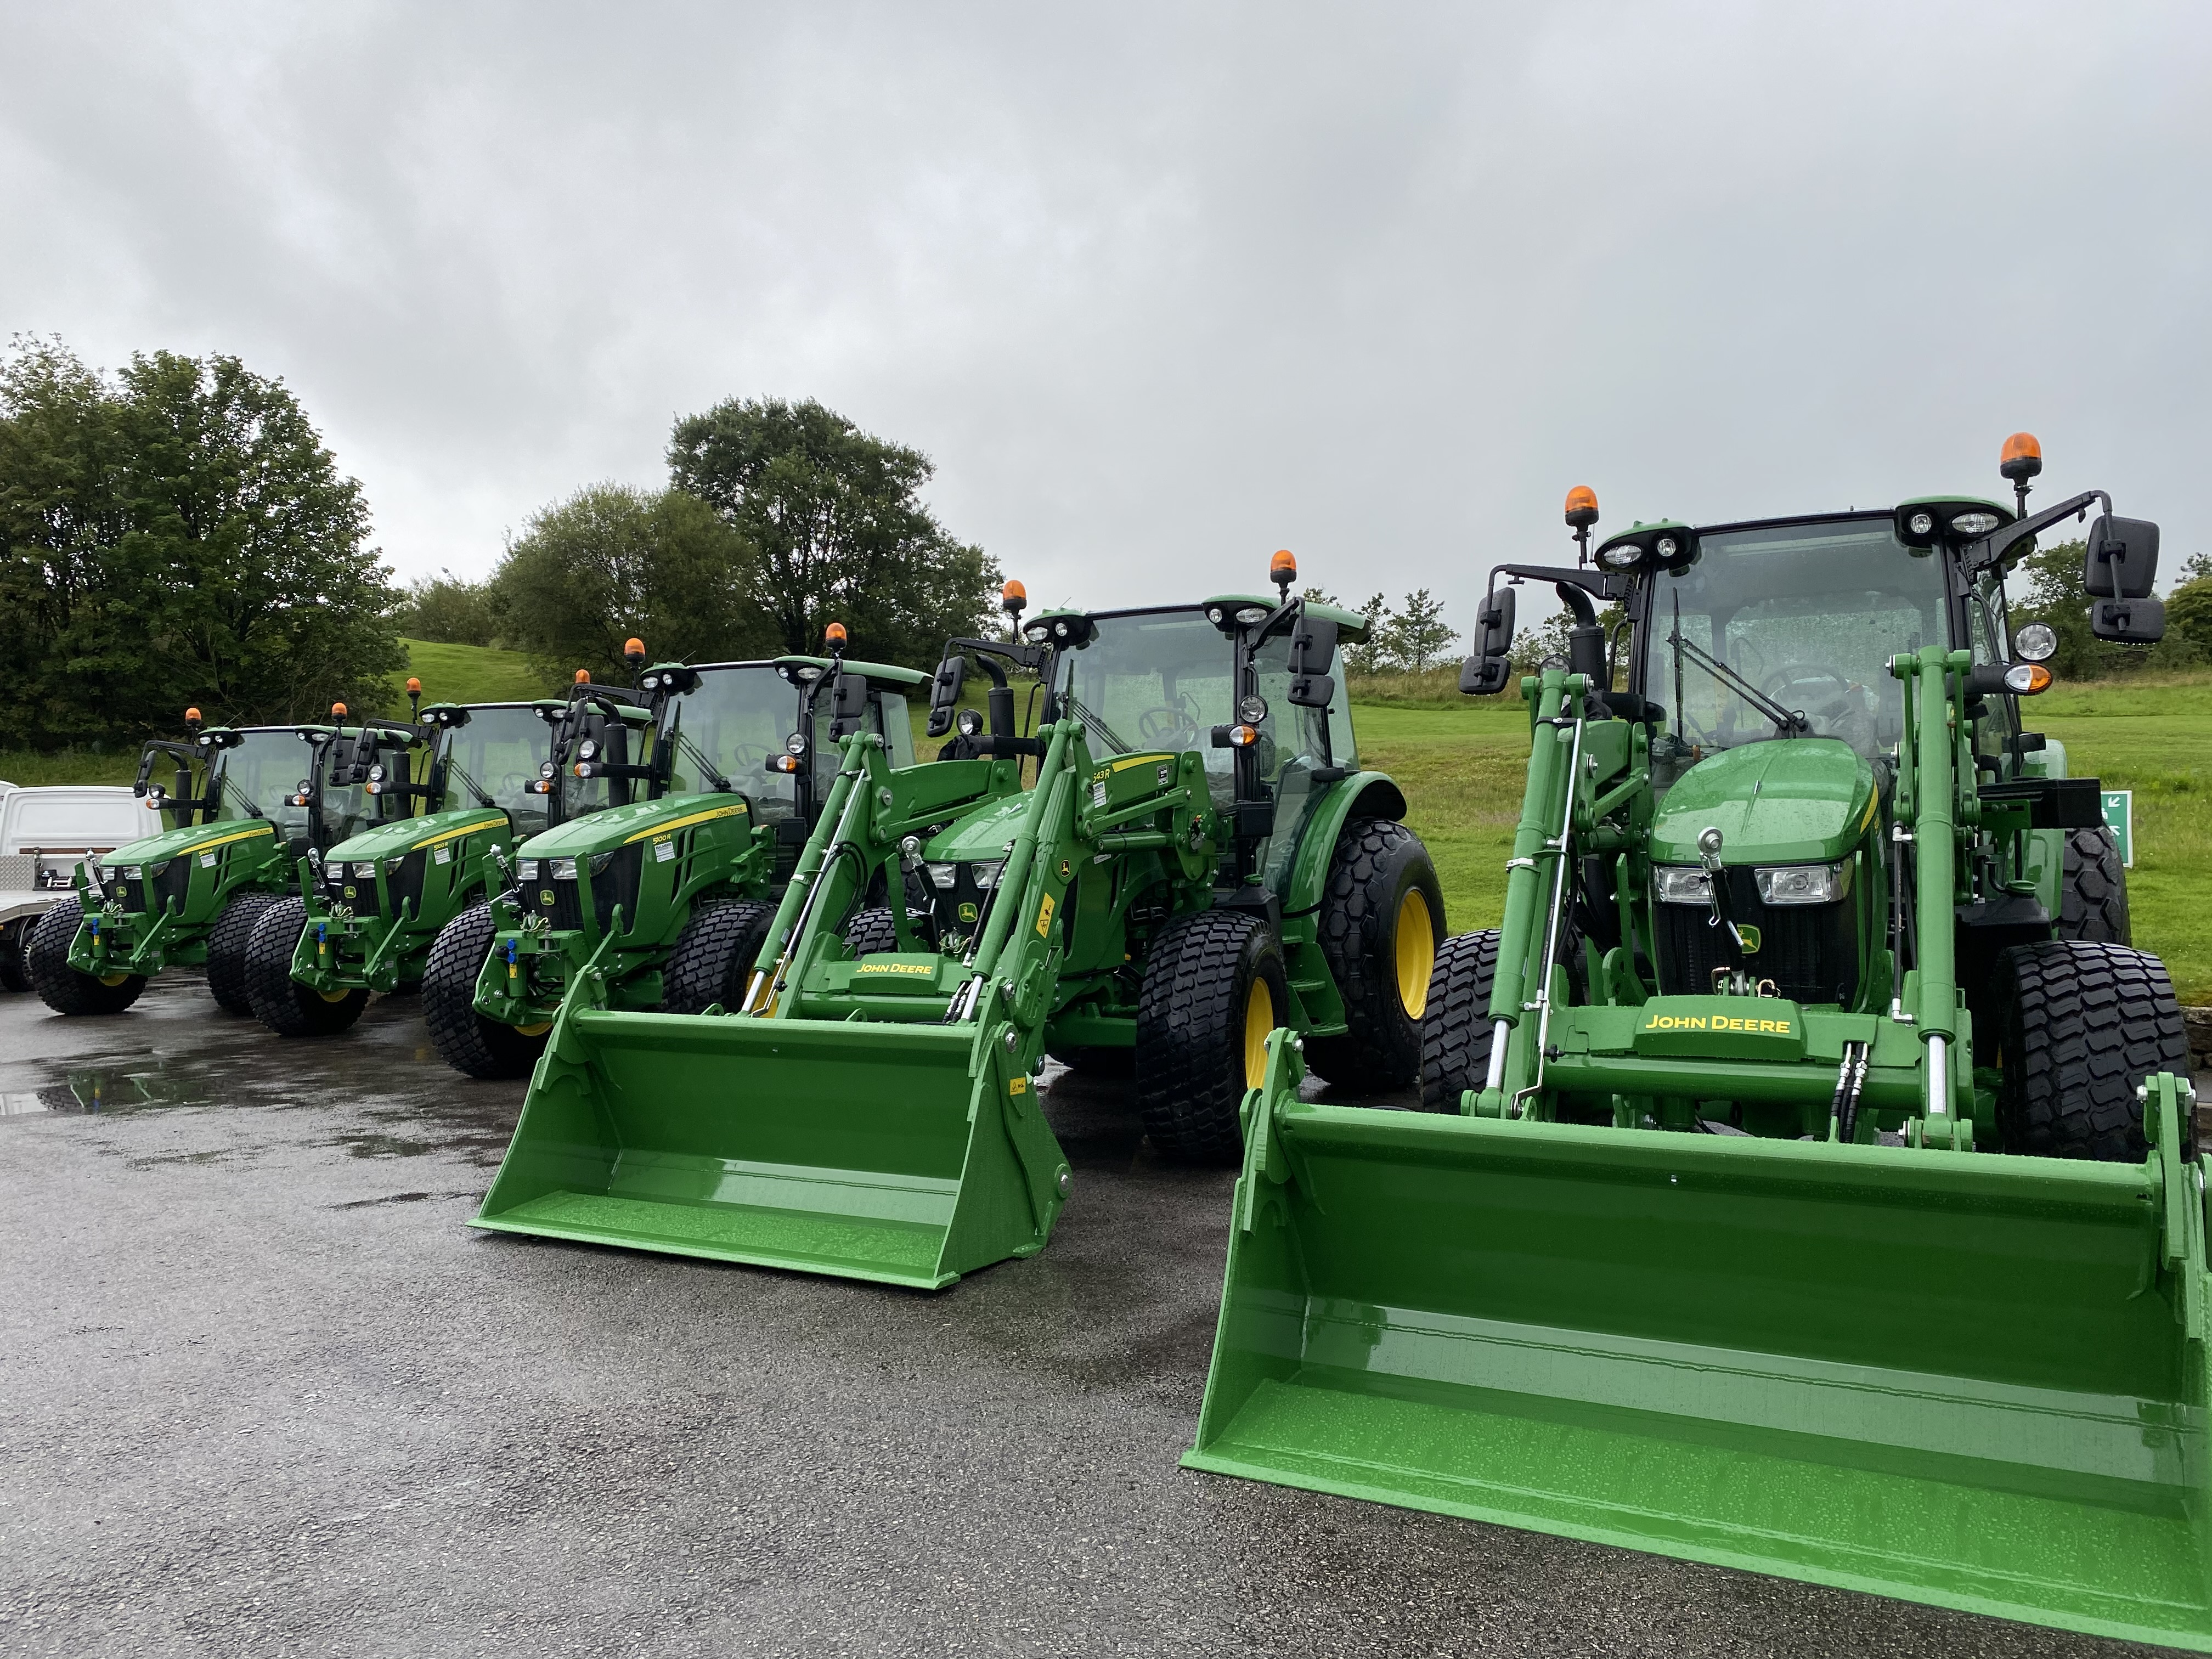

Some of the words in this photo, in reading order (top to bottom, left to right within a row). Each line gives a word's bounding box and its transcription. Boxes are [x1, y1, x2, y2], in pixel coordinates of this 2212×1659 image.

[716, 809, 729, 817] JOHN
[729, 807, 743, 816] DEERE
[856, 963, 890, 973] JOHN
[890, 963, 933, 974] DEERE
[1645, 1014, 1707, 1029] JOHN
[1711, 1015, 1791, 1034] DEERE
